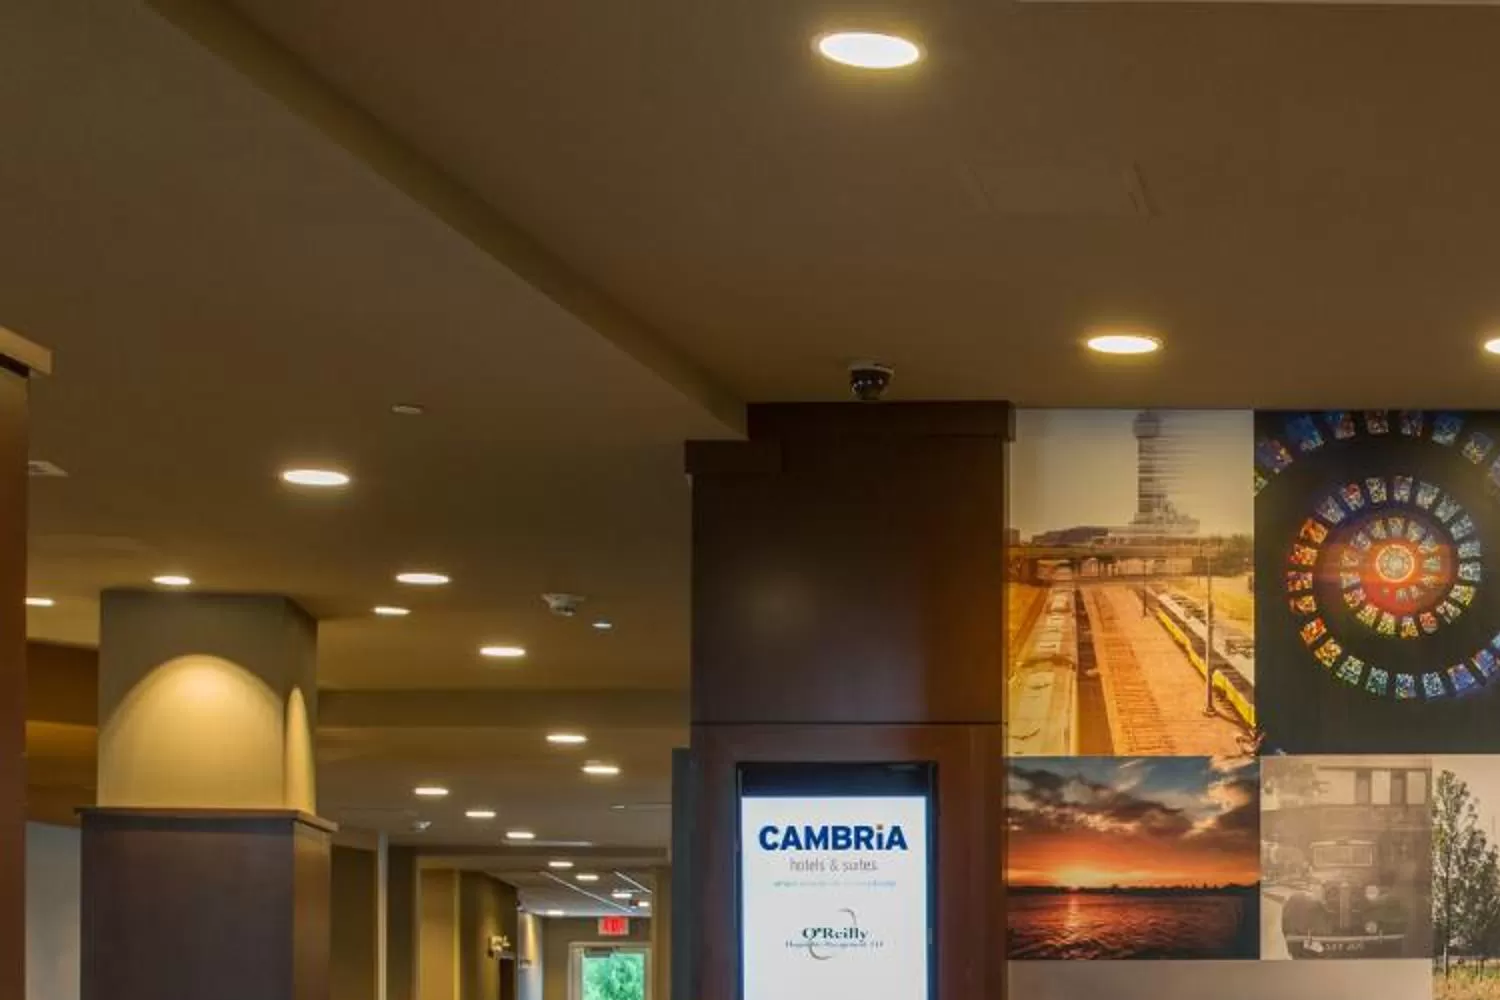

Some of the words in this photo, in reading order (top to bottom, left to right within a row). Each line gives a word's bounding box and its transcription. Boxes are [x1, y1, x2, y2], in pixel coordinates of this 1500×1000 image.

[789, 858, 826, 872] hotels
[829, 858, 841, 872] &
[842, 858, 880, 873] suites
